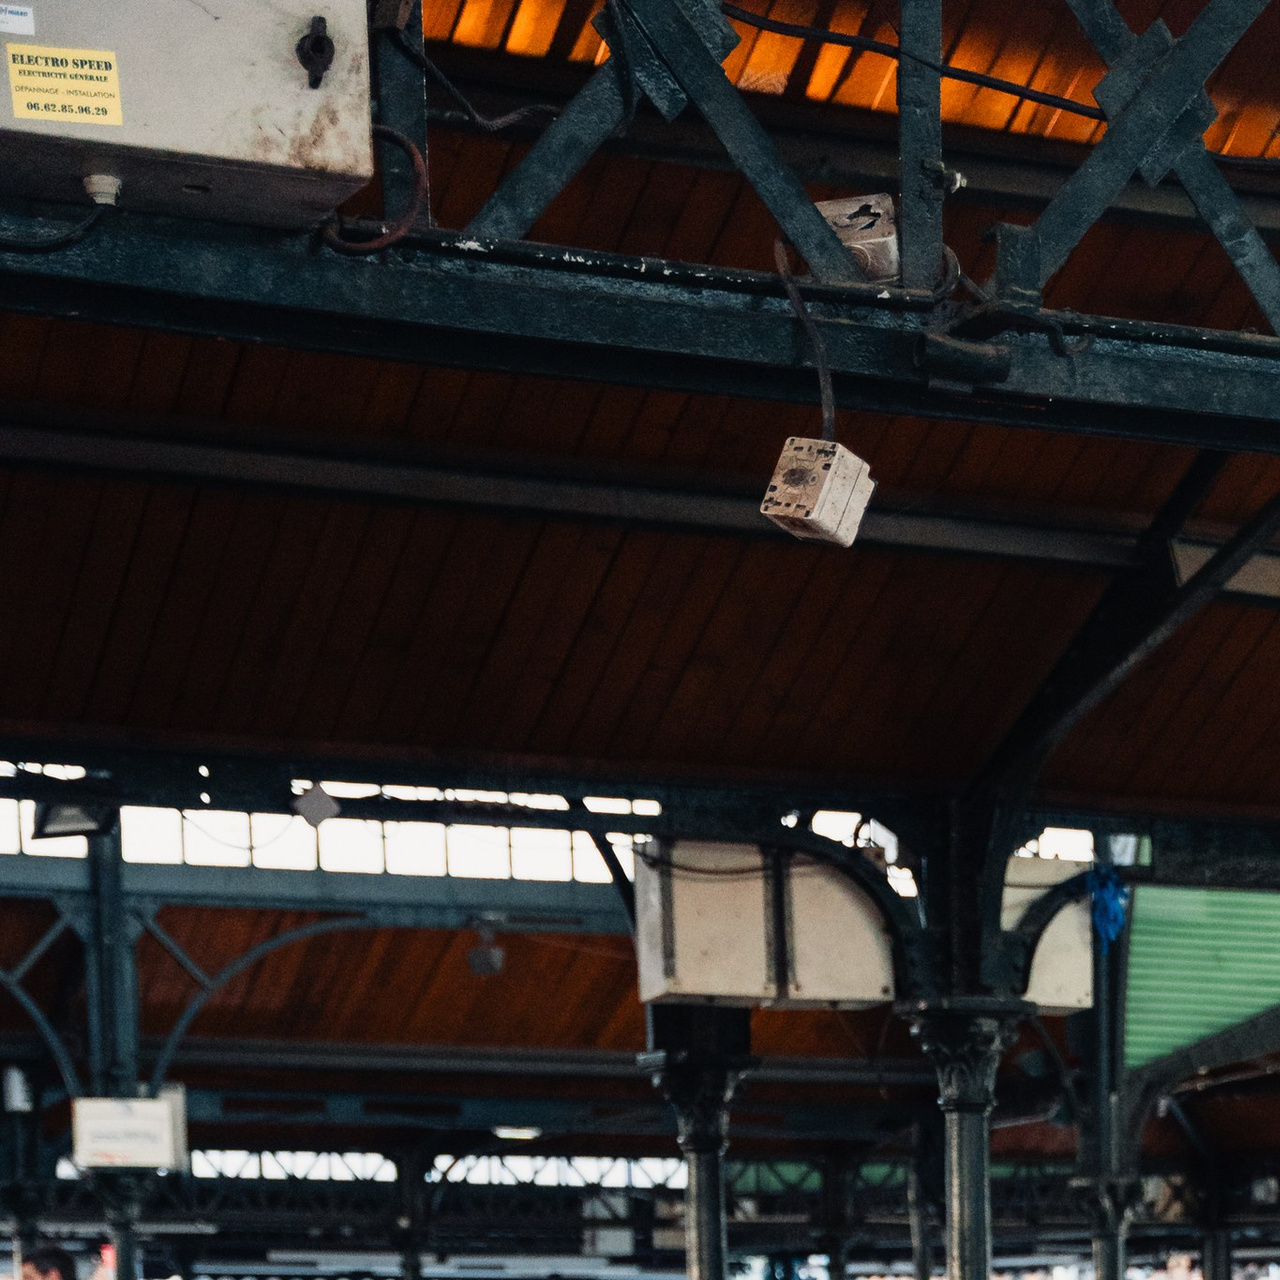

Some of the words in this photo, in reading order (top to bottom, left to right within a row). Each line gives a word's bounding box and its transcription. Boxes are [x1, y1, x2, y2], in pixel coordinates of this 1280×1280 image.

[11, 53, 69, 68] ELECTRO
[72, 58, 113, 71] SPEED
[66, 89, 116, 99] INSTALLATION
[26, 101, 108, 116] 06.62.85.96.29
